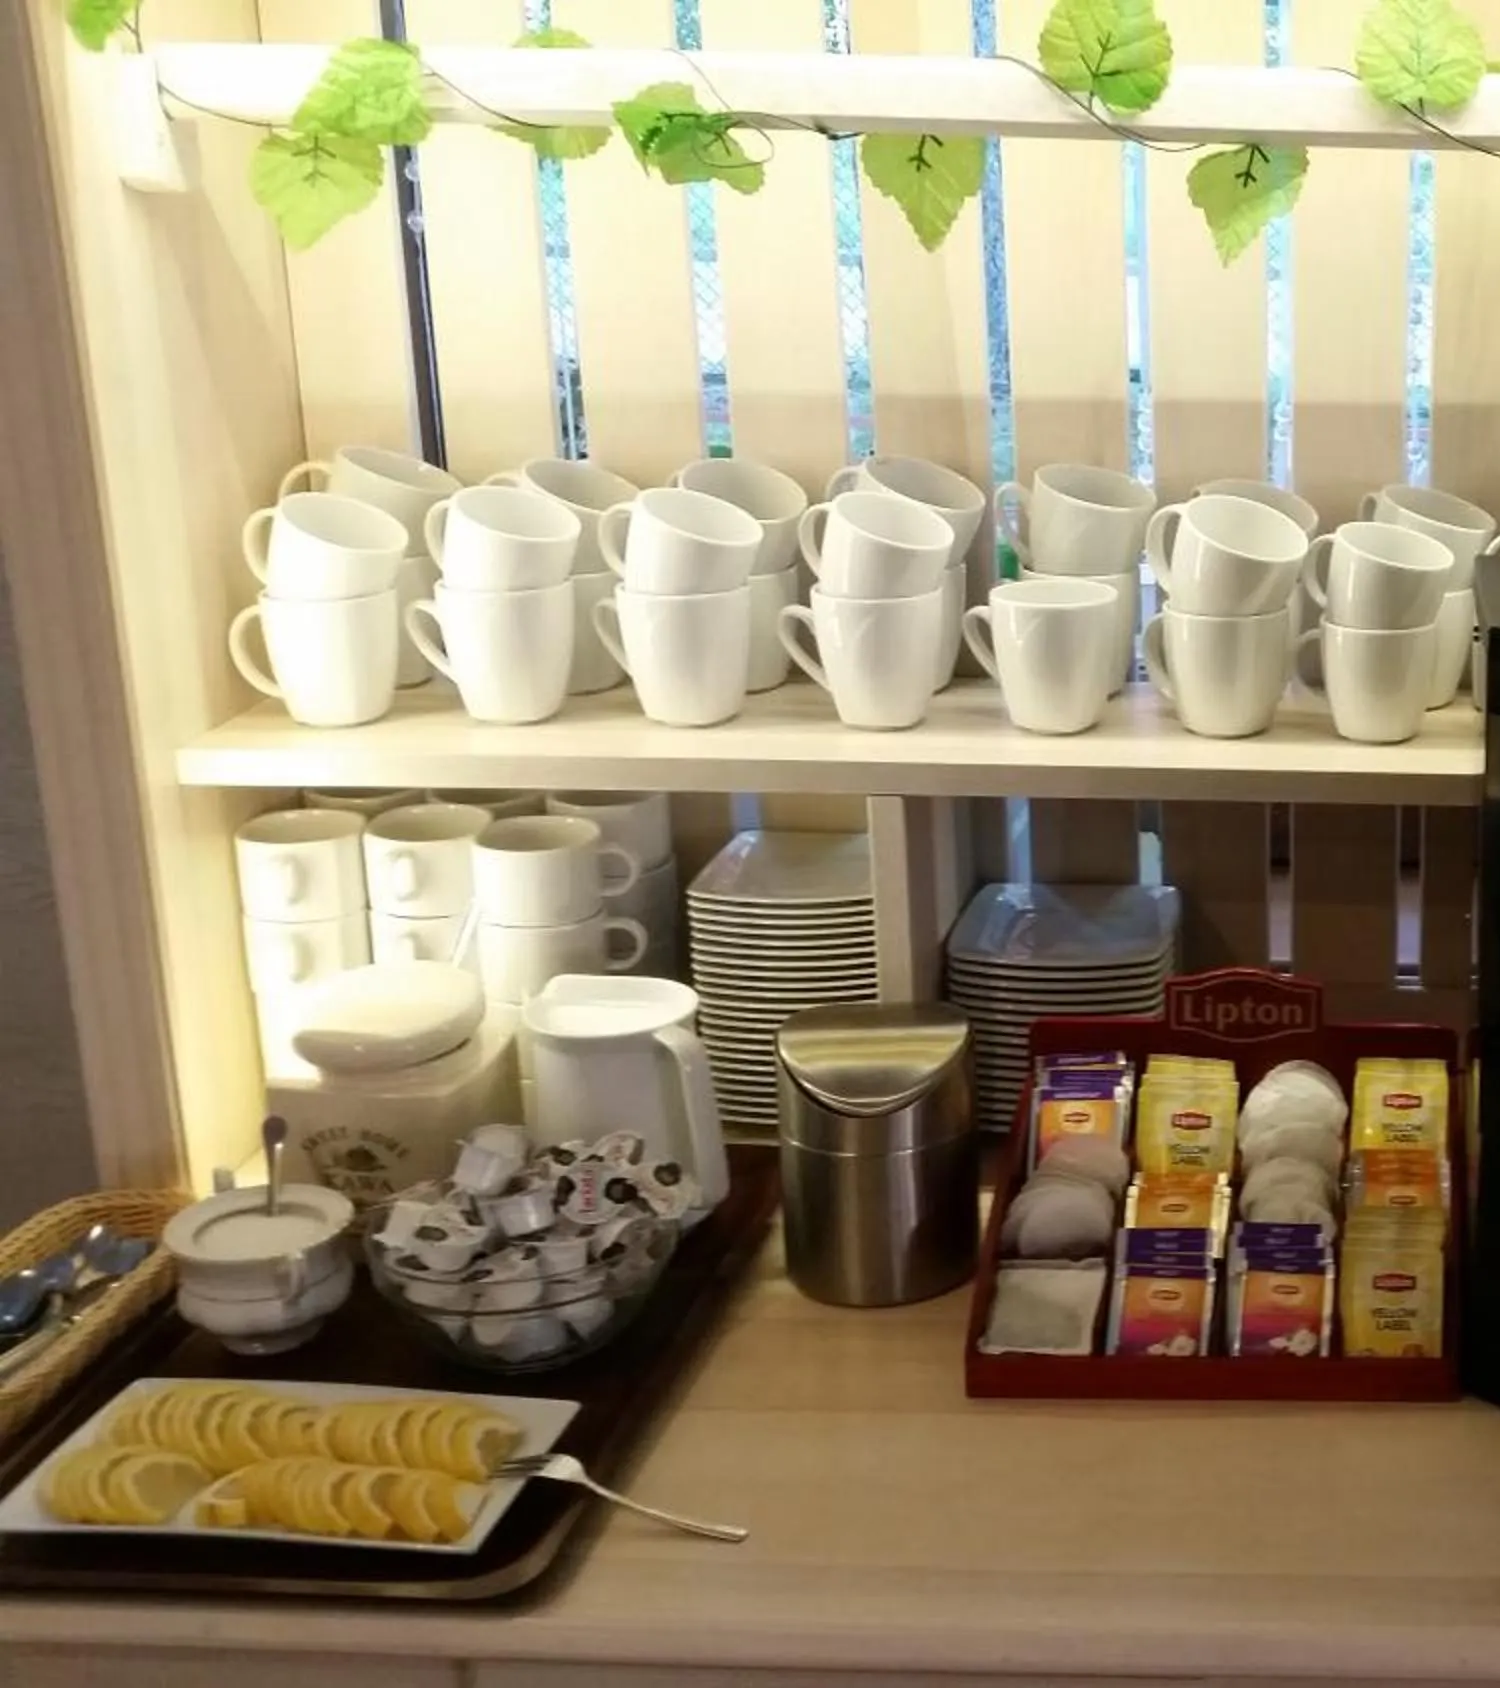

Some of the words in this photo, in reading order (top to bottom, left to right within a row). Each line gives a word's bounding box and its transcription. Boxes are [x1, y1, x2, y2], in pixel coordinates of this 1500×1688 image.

[1182, 994, 1304, 1033] Lipton
[1381, 1122, 1423, 1133] YELLOW
[1383, 1133, 1419, 1143] LABEL
[1371, 1307, 1418, 1319] YELLOW
[1375, 1319, 1412, 1331] LABEL
